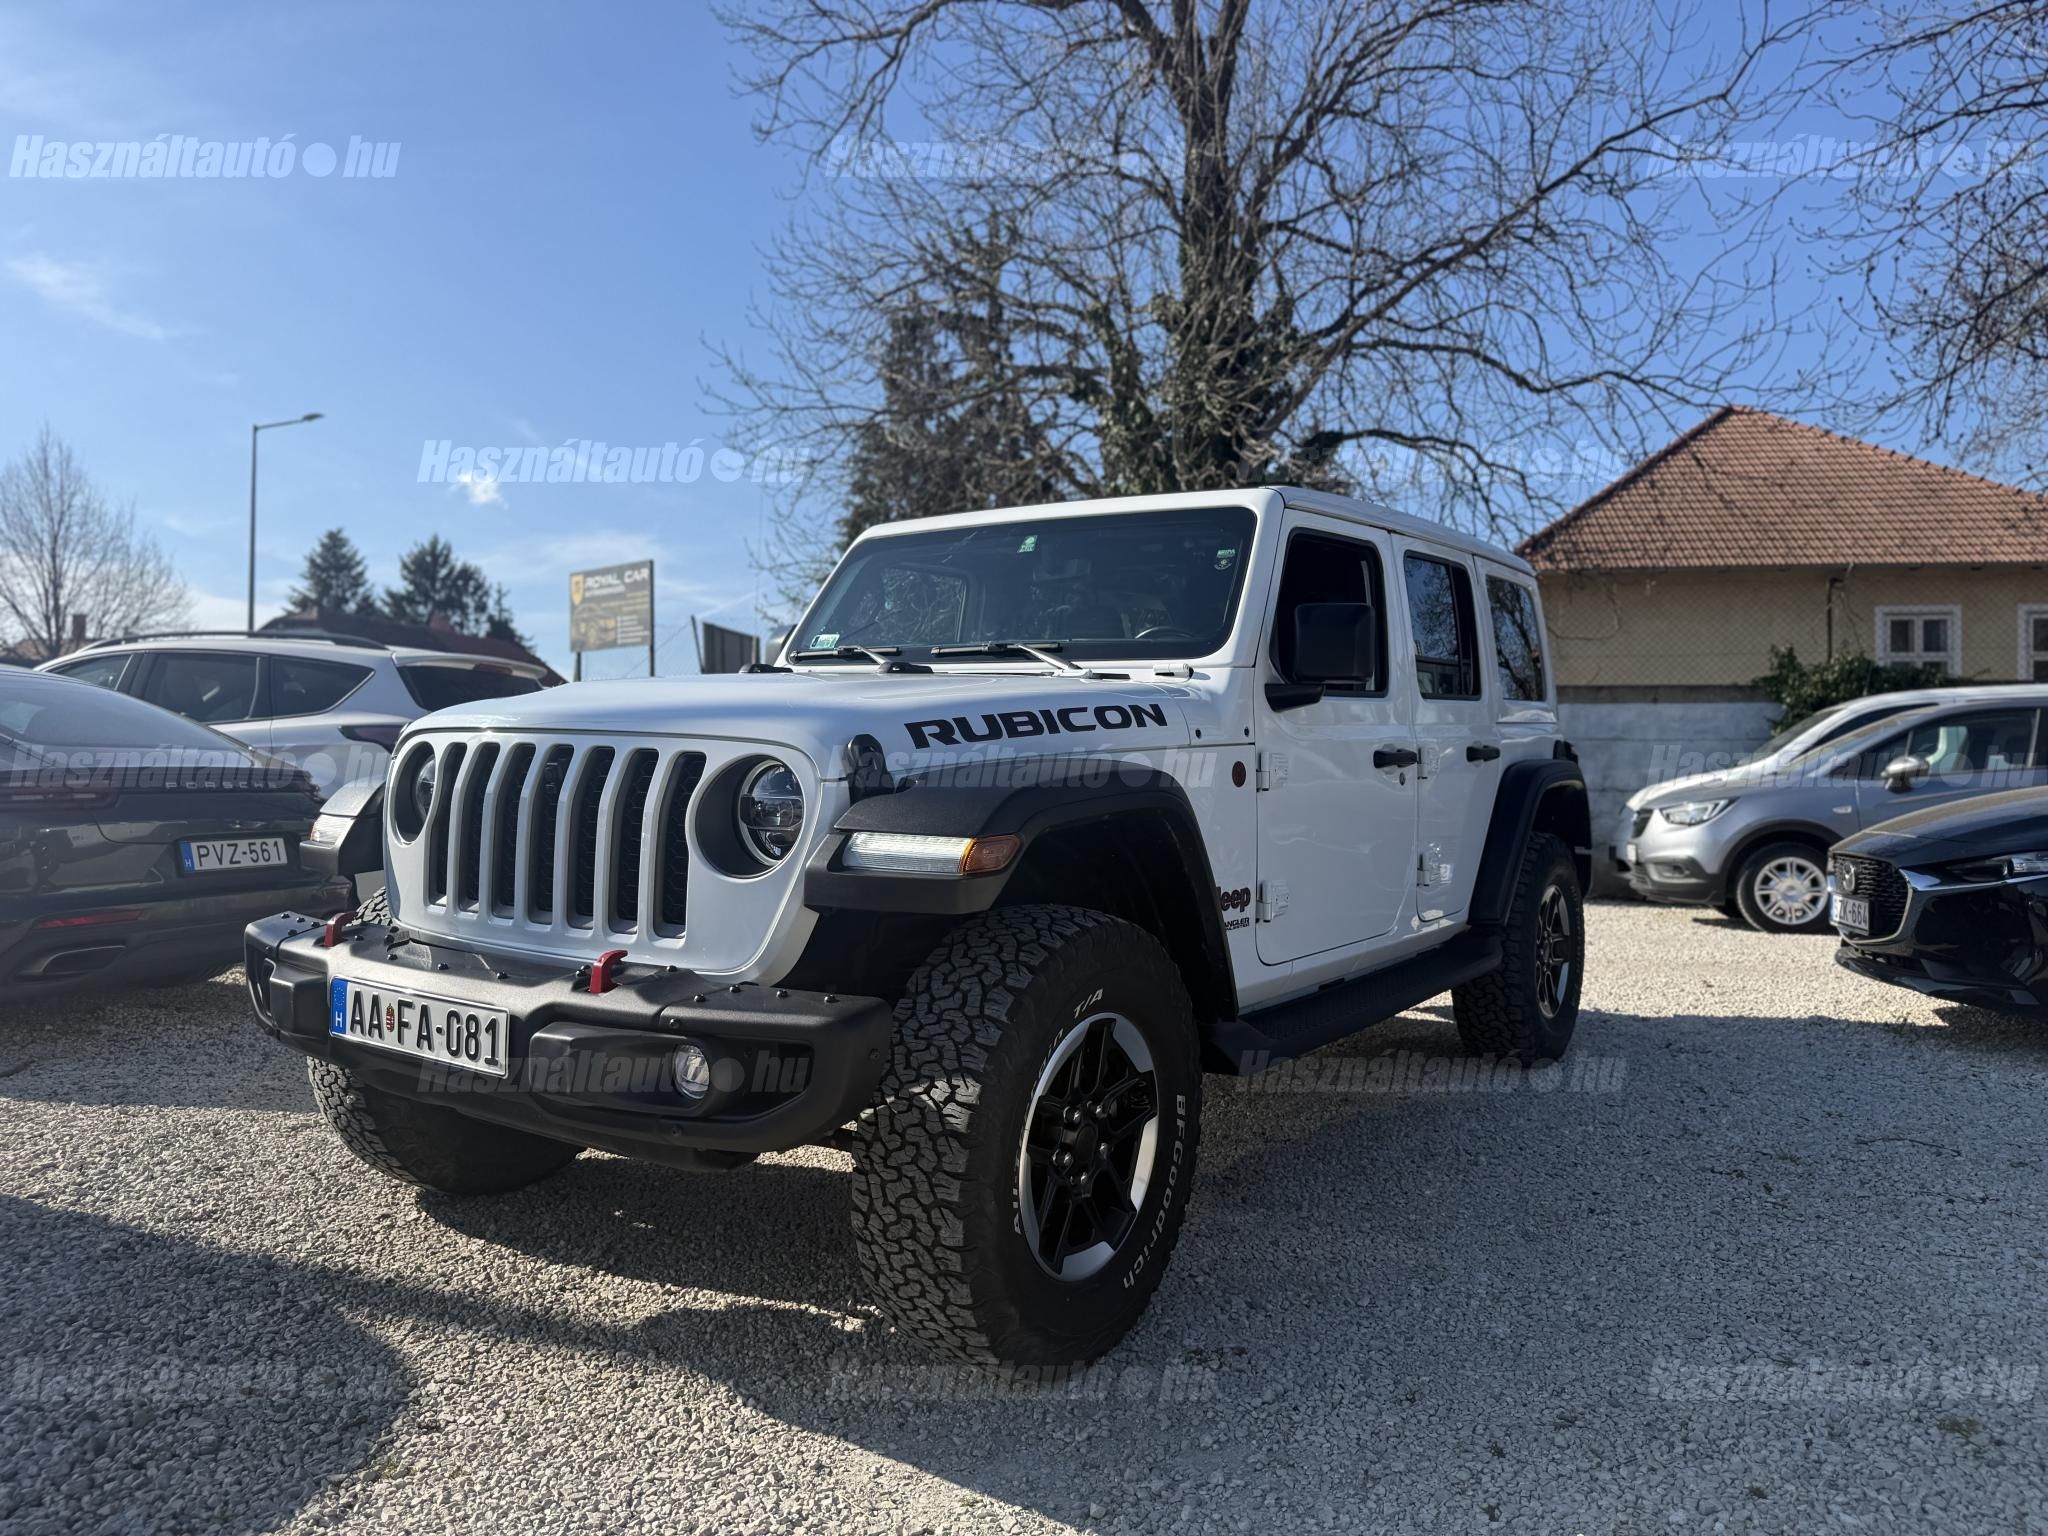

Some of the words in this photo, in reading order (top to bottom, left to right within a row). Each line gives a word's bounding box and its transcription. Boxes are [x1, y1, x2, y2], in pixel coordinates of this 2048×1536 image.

[624, 567, 650, 584] CAR
[904, 703, 1168, 750] RUBICON
[165, 781, 278, 790] PORSCHE
[196, 840, 283, 867] PVZ-561
[1122, 1094, 1187, 1289] BFGoodrich
